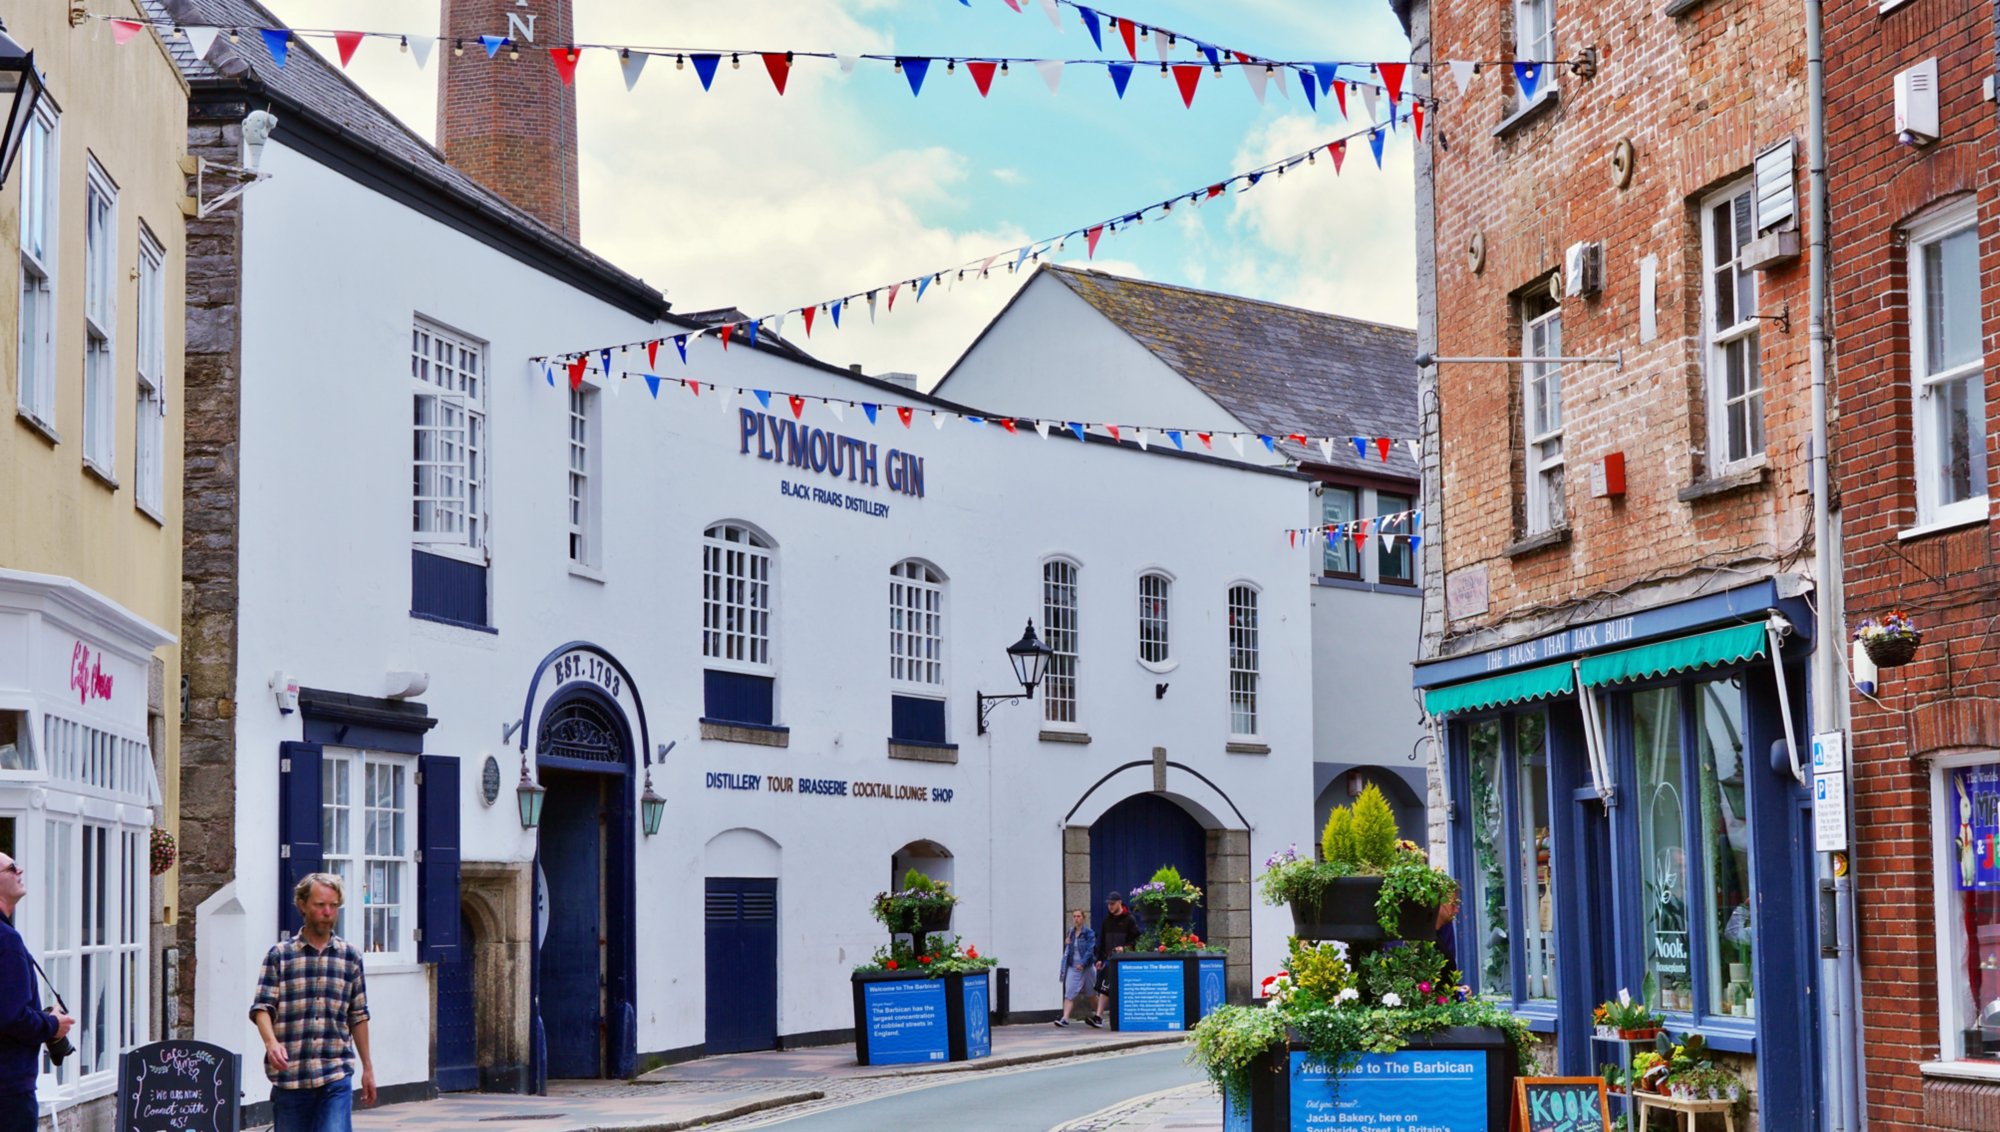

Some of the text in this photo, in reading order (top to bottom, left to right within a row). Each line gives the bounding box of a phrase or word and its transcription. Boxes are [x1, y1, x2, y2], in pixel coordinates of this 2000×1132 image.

[506, 0, 537, 42] N
[739, 407, 925, 498] PLYMOUTH GIN
[781, 480, 889, 518] BLACK FRIARS DISTILLERY
[1486, 617, 1634, 671] THE HOUSE THAT JACK BUILT
[555, 655, 620, 697] EST. 1793
[706, 772, 953, 803] DISTILLERY TOUR BRASSERIE COCKTAIL LOUNGE SHOP
[1818, 781, 1825, 798] P
[1977, 839, 1985, 855] &
[1655, 937, 1687, 959] Nook.
[1301, 1061, 1474, 1074] Welcoe to The Barbican
[180, 1101, 208, 1115] with
[1305, 1099, 1320, 1108] Did
[1530, 1090, 1602, 1122] KOOK
[1306, 1113, 1417, 1125] Jacka Bakery, here on
